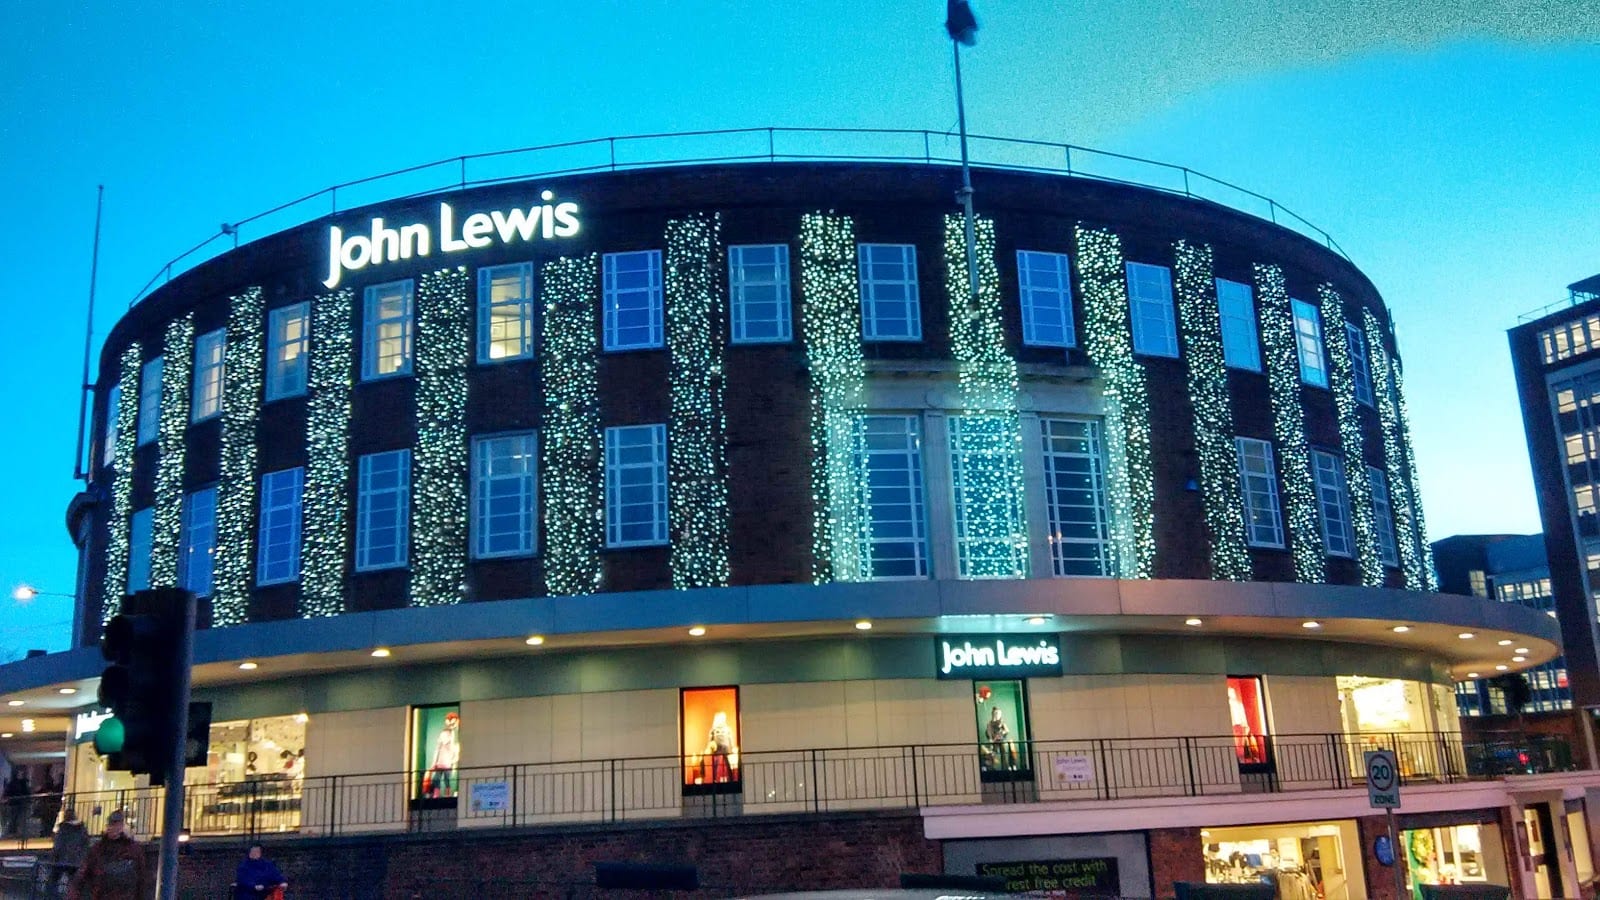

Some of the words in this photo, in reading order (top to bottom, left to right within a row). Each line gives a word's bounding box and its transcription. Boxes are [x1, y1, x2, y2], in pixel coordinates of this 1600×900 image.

[322, 217, 430, 289] John
[440, 189, 580, 252] Lewis
[941, 641, 995, 674] John
[996, 639, 1060, 666] Lewis
[1372, 765, 1389, 780] 20
[1374, 795, 1396, 804] ZONE
[982, 864, 1024, 879] Spread
[1028, 863, 1049, 876] the
[1052, 861, 1078, 875] cost
[1081, 859, 1108, 873] with
[1006, 878, 1030, 891] rest
[1034, 876, 1058, 890] free
[1062, 874, 1096, 889] credit
